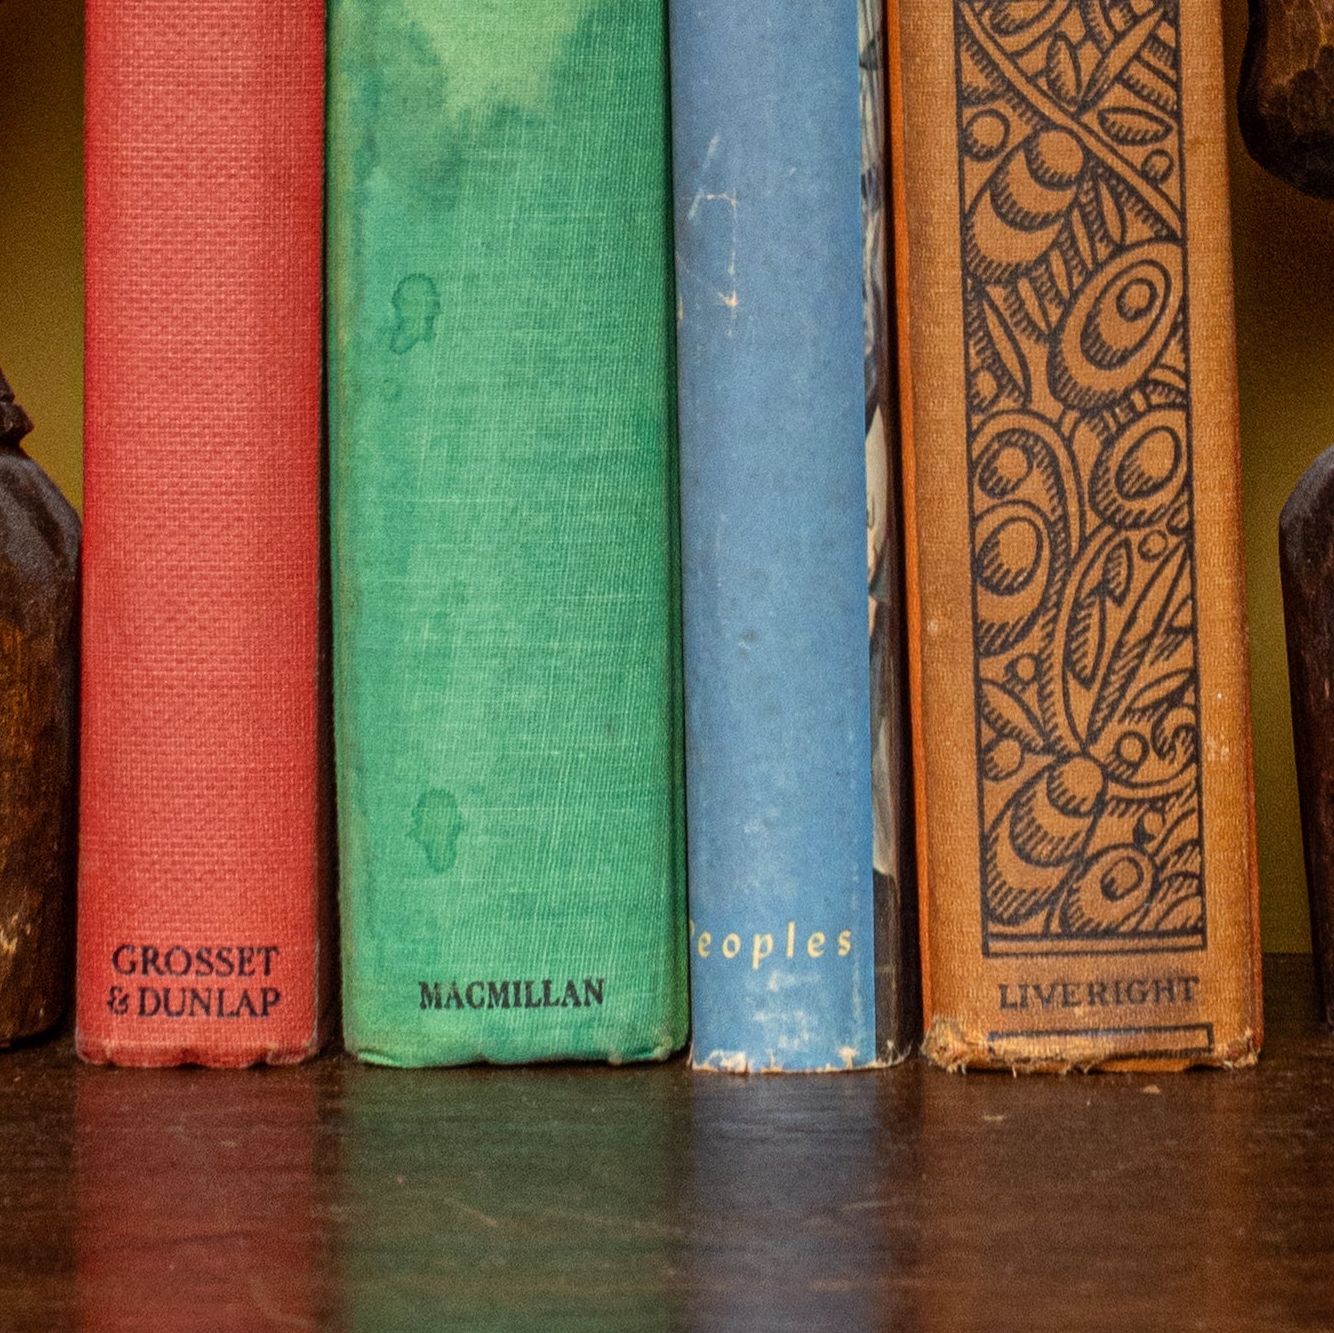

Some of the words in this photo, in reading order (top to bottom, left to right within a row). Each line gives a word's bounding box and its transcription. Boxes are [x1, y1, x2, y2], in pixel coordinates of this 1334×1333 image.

[112, 944, 280, 977] GROSSET
[690, 920, 853, 970] eoples
[107, 987, 129, 1015] &
[138, 988, 281, 1018] DUNLAP
[418, 978, 605, 1011] MACMILLAN
[999, 975, 1200, 1010] LIVERIGHT
